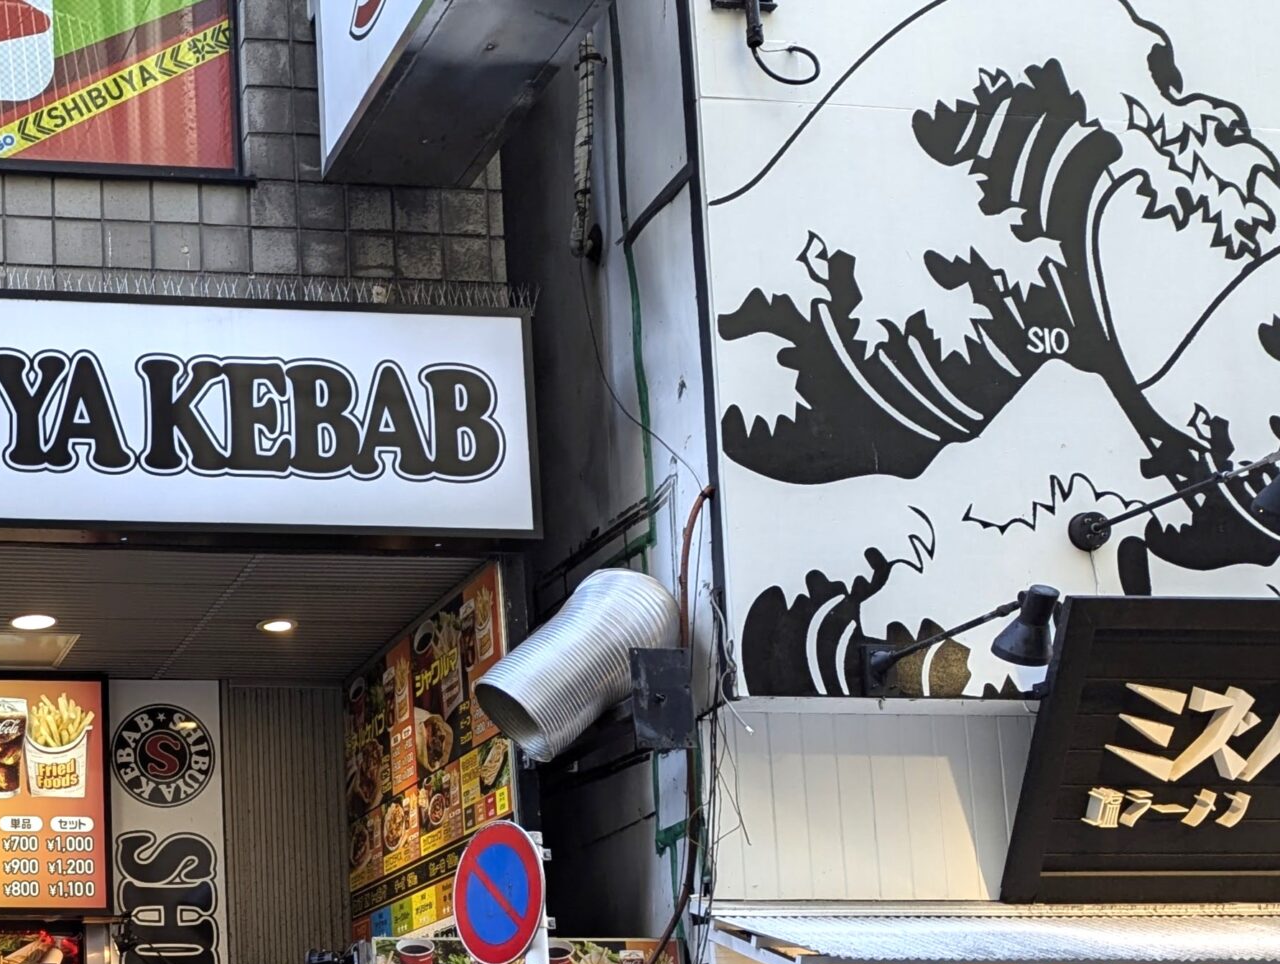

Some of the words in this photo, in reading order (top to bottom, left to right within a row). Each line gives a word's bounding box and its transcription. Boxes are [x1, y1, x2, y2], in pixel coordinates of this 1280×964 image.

[46, 65, 159, 130] SHIBUYA
[1026, 326, 1070, 355] SIO
[134, 354, 501, 484] KEBAB
[37, 758, 75, 776] Fried
[36, 772, 79, 790] Foods
[11, 819, 32, 830] 単品
[58, 819, 85, 830] セット
[2, 836, 38, 852] ¥700
[46, 836, 93, 853] ¥1,000
[3, 859, 39, 875] ¥900
[47, 859, 94, 876] ¥1,200
[3, 881, 40, 898] ¥800
[49, 881, 95, 898] ¥1,100
